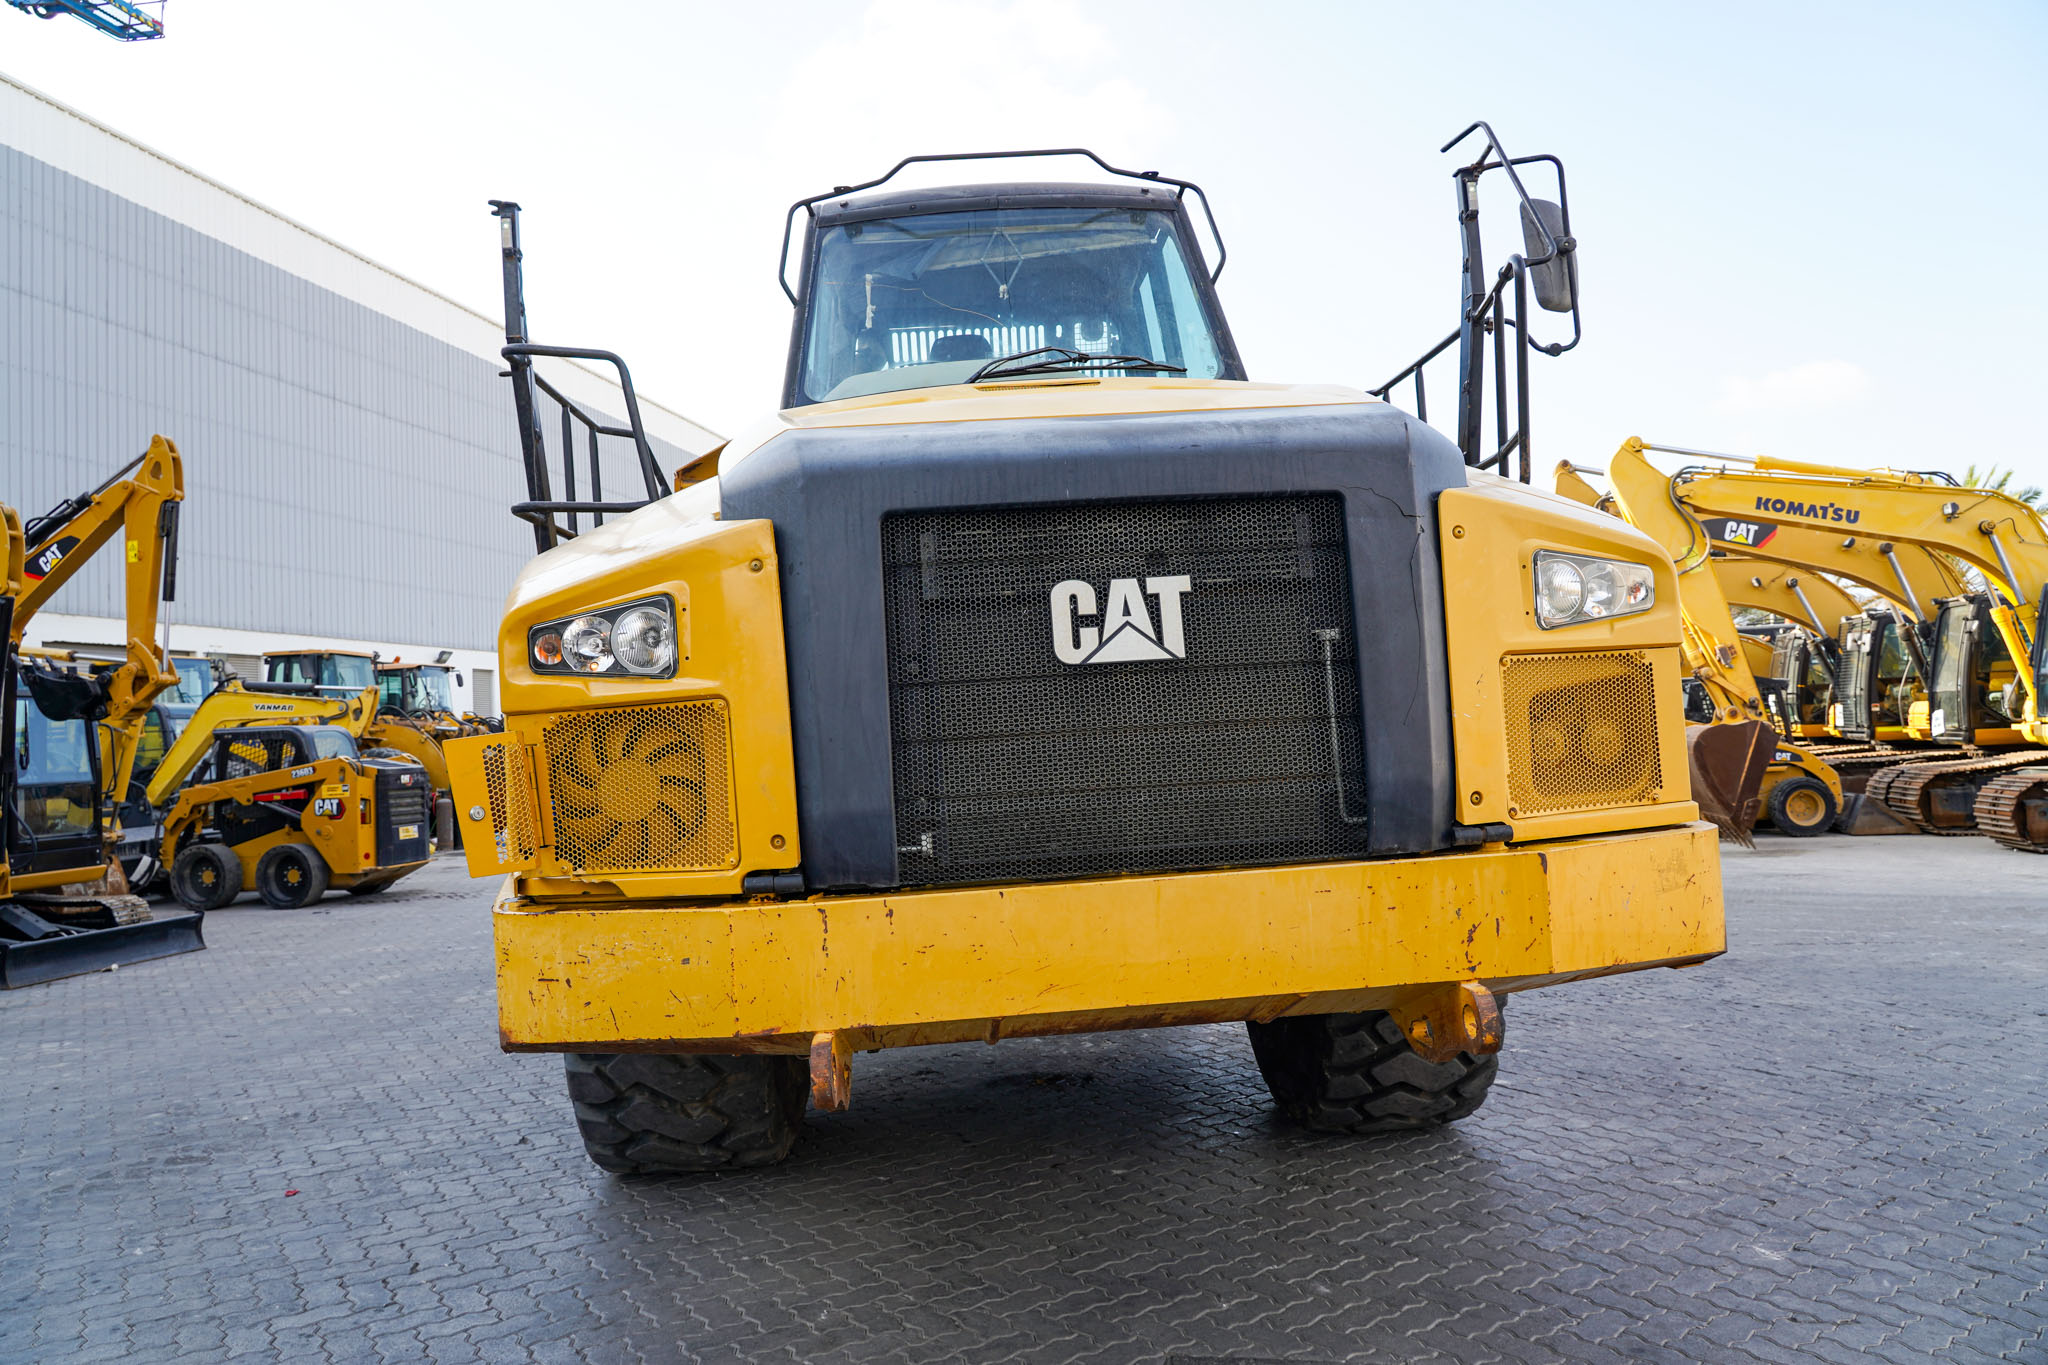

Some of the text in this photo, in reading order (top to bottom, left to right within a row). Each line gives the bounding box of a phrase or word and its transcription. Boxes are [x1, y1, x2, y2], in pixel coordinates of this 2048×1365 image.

[1755, 496, 1860, 524] KOMATSU
[1724, 520, 1758, 545] CAT
[39, 543, 63, 573] CAT
[1051, 575, 1192, 665] CAT
[254, 704, 295, 712] YANMAR
[1775, 752, 1792, 761] CAT
[314, 798, 340, 816] CAT
